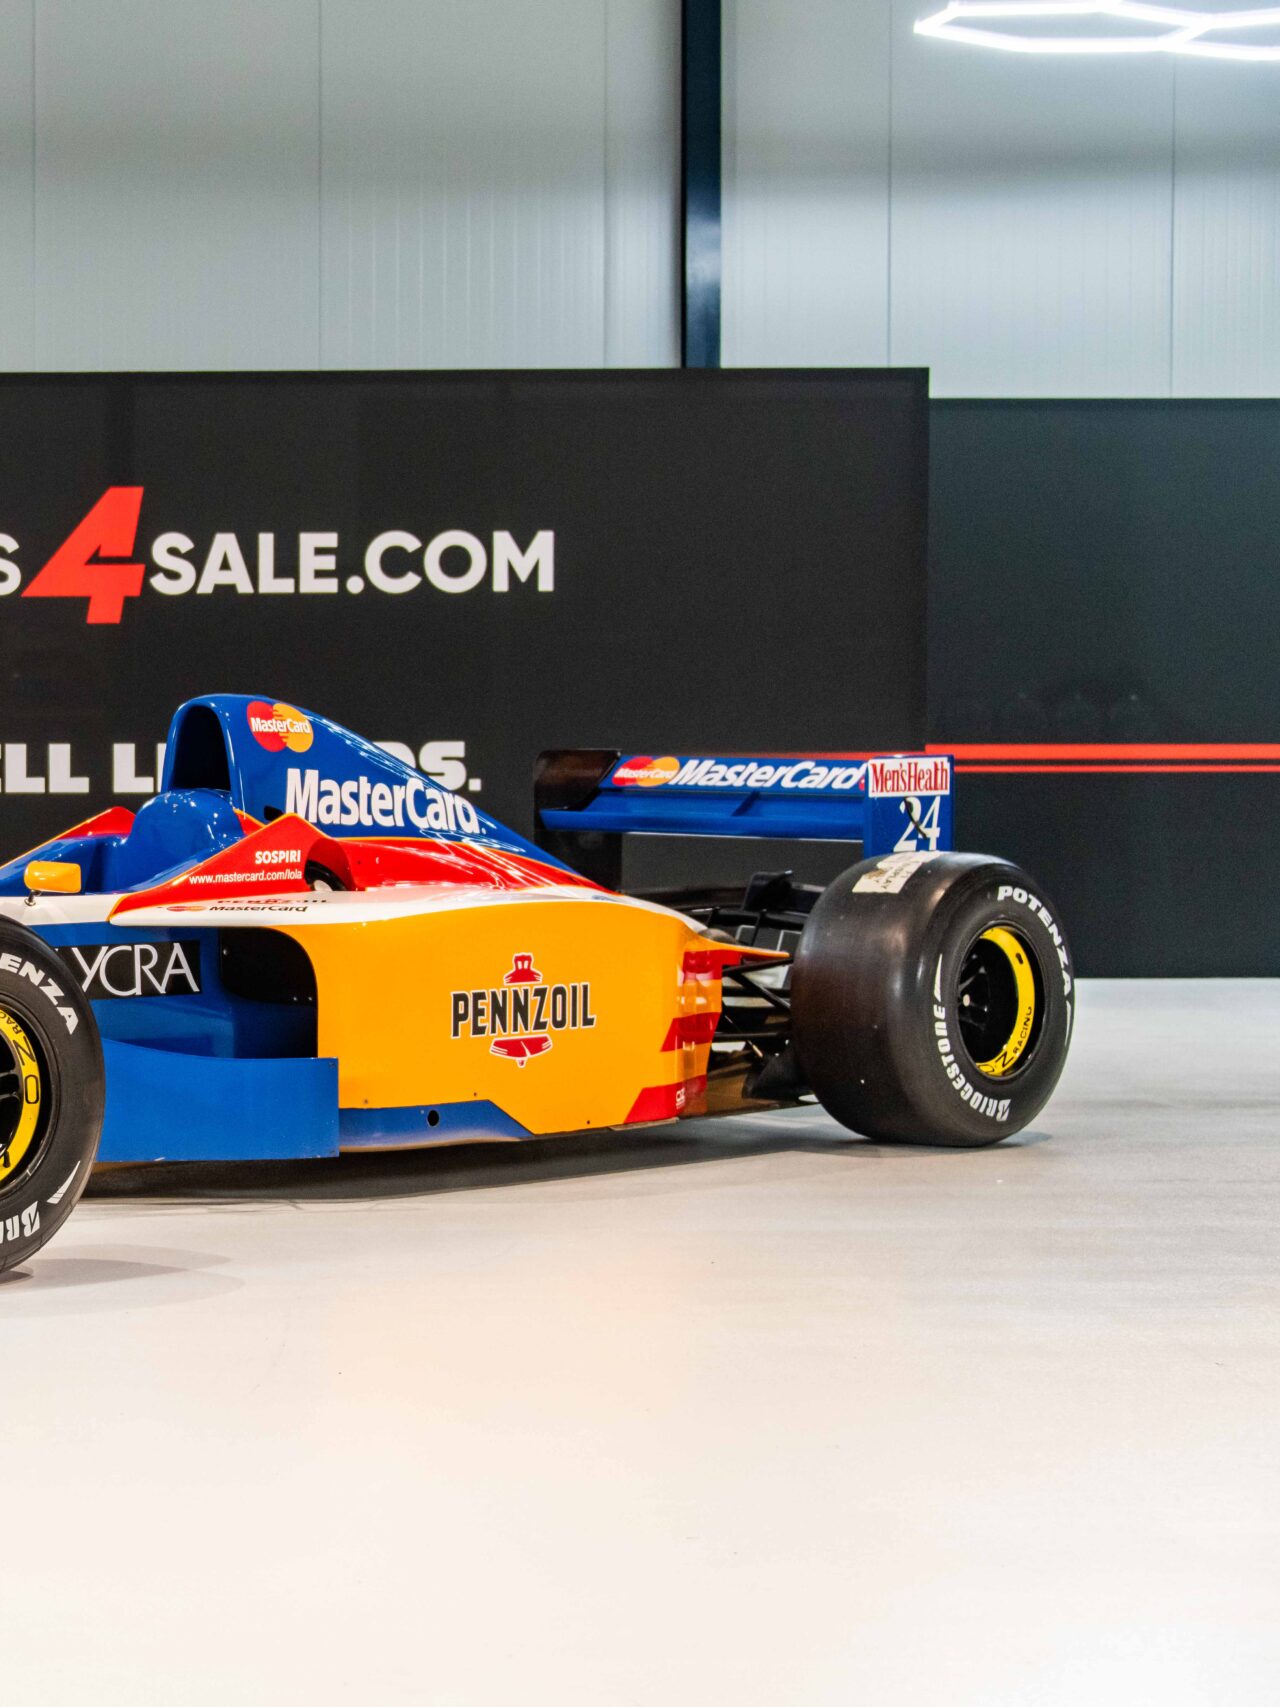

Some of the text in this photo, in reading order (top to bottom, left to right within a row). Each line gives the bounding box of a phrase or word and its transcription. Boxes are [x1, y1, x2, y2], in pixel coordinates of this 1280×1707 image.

[250, 717, 311, 734] MasterCard
[285, 768, 480, 834] MasterCard
[668, 759, 867, 789] MasterCard
[893, 796, 941, 852] 24
[189, 868, 302, 885] www.mastercard.com/lola
[255, 850, 301, 864] SOSPIRI
[997, 885, 1072, 997] POTENZA
[70, 942, 201, 997] YCRA
[451, 983, 596, 1038] PENNZOIL
[933, 1004, 1012, 1122] BRIDGESTONE
